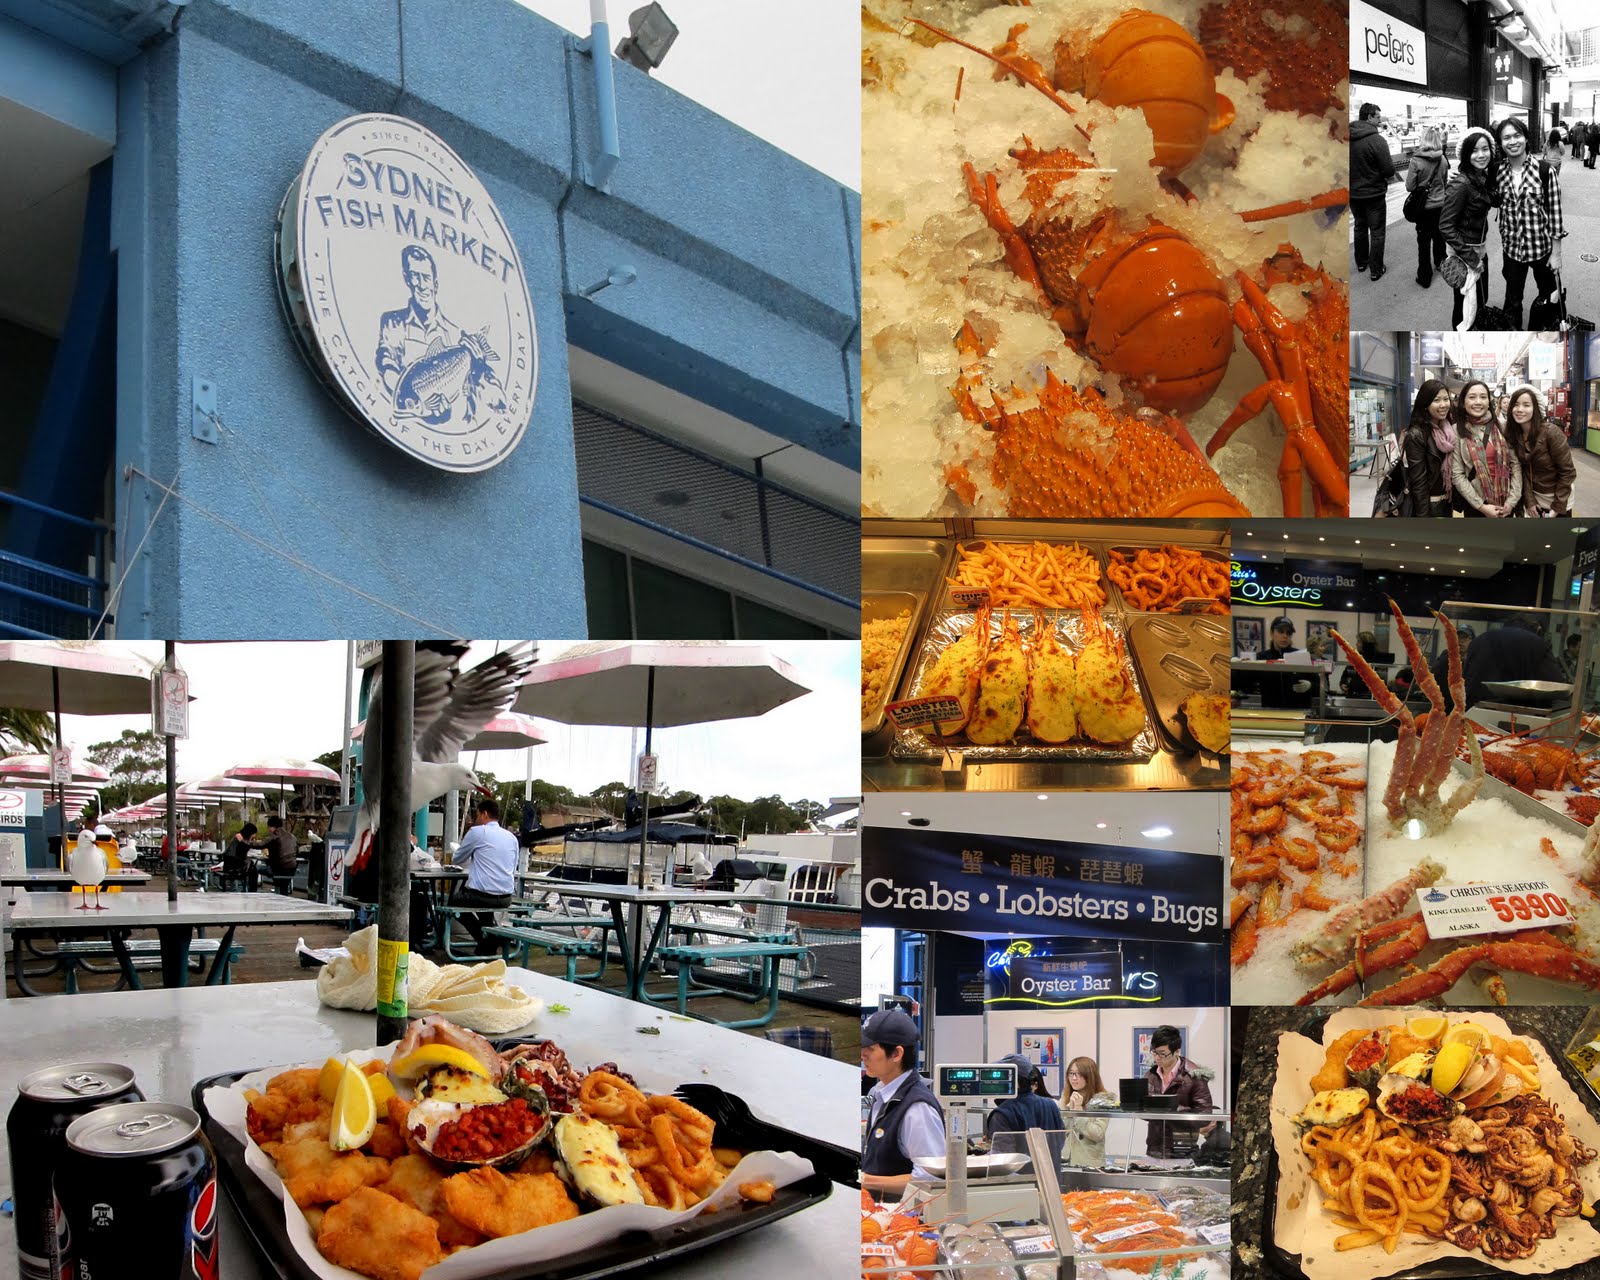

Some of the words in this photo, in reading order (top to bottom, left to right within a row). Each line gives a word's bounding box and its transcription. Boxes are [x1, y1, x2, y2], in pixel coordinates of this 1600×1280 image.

[1365, 24, 1415, 65] peter's
[372, 131, 408, 143] SINCE
[343, 152, 472, 224] SYDNEY
[315, 194, 385, 229] FISH
[393, 203, 514, 283] MARKET
[315, 274, 331, 318] THE
[332, 334, 376, 406] CATCH
[388, 416, 410, 434] OF
[421, 436, 453, 455] THE
[496, 381, 523, 435] EVERY
[517, 332, 526, 370] DAY
[1292, 573, 1333, 587] Oyster
[1336, 575, 1356, 587] Bar
[1242, 582, 1322, 600] Oysters
[891, 700, 958, 716] LOBSTER
[1450, 885, 1502, 898] CHRISTIE'S
[1502, 881, 1549, 894] SEAFOODS
[865, 878, 970, 912] Crabs
[996, 885, 1129, 920] Lobsters
[1151, 895, 1218, 933] Bugs
[1428, 908, 1448, 916] KING
[1449, 923, 1480, 931] ALASKA
[1021, 977, 1078, 997] Oyster
[1082, 975, 1112, 990] Bar
